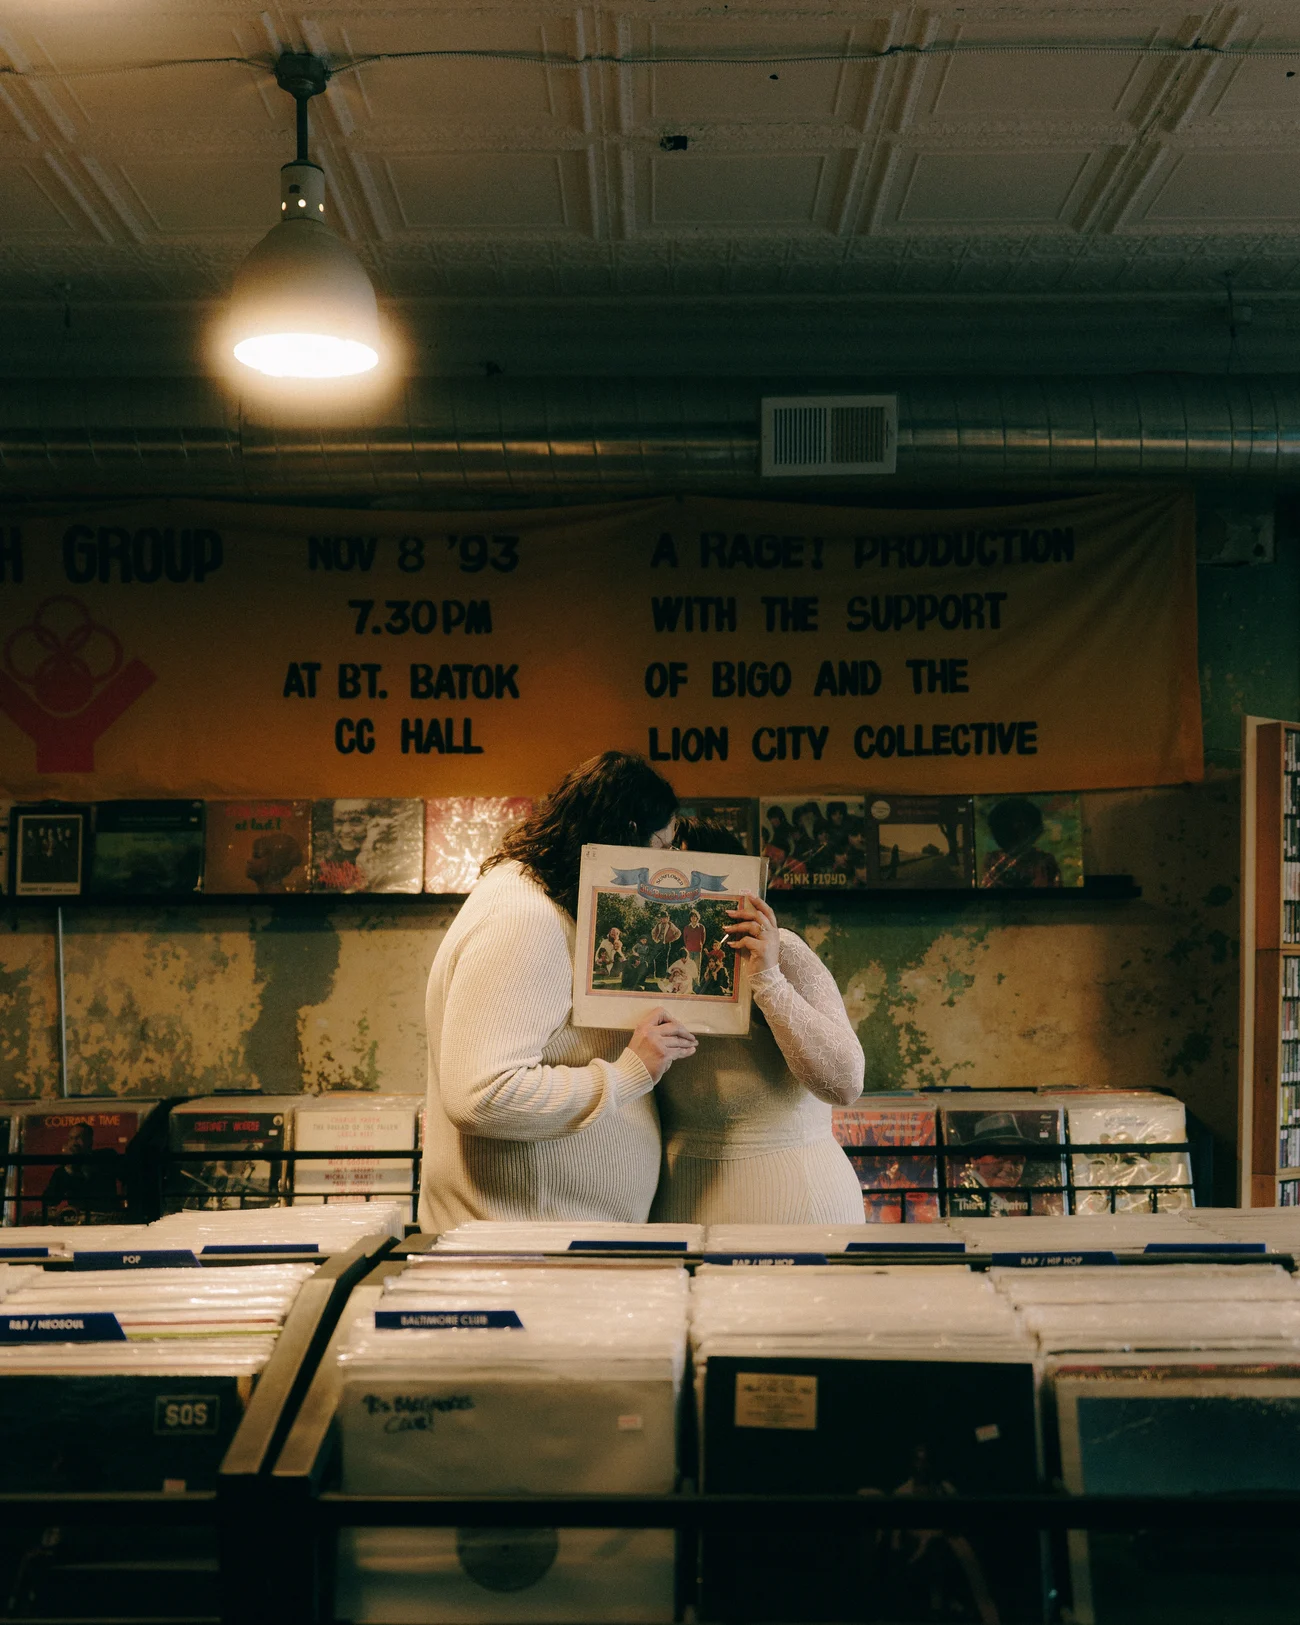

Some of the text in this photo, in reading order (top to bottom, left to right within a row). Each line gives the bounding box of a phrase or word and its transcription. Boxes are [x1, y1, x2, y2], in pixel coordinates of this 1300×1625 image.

[62, 525, 223, 583] GROUP
[308, 535, 520, 572] NOV 8 '93
[650, 526, 1074, 570] A RAGE! PRODUCTION
[652, 592, 1007, 632] WITH THE SUPPORT
[284, 662, 520, 699] AT BT. BATOK
[645, 658, 968, 698] OF BIGO AND THE
[335, 718, 484, 754] CC HALL
[649, 721, 1038, 762] LION CITY COLLECTIVE
[656, 874, 684, 886] SUNFLOWER
[813, 873, 846, 884] FLOYD
[44, 1114, 120, 1128] COLTRANE TIME
[122, 1256, 141, 1264] POP
[1020, 1257, 1038, 1265] RAP
[1047, 1256, 1062, 1265] HIP
[1063, 1256, 1083, 1265] HOP
[8, 1319, 28, 1330] R&B
[38, 1318, 84, 1330] NEOSOUL
[400, 1314, 488, 1326] BALTIMORE CLUB
[165, 1402, 208, 1426] SOS
